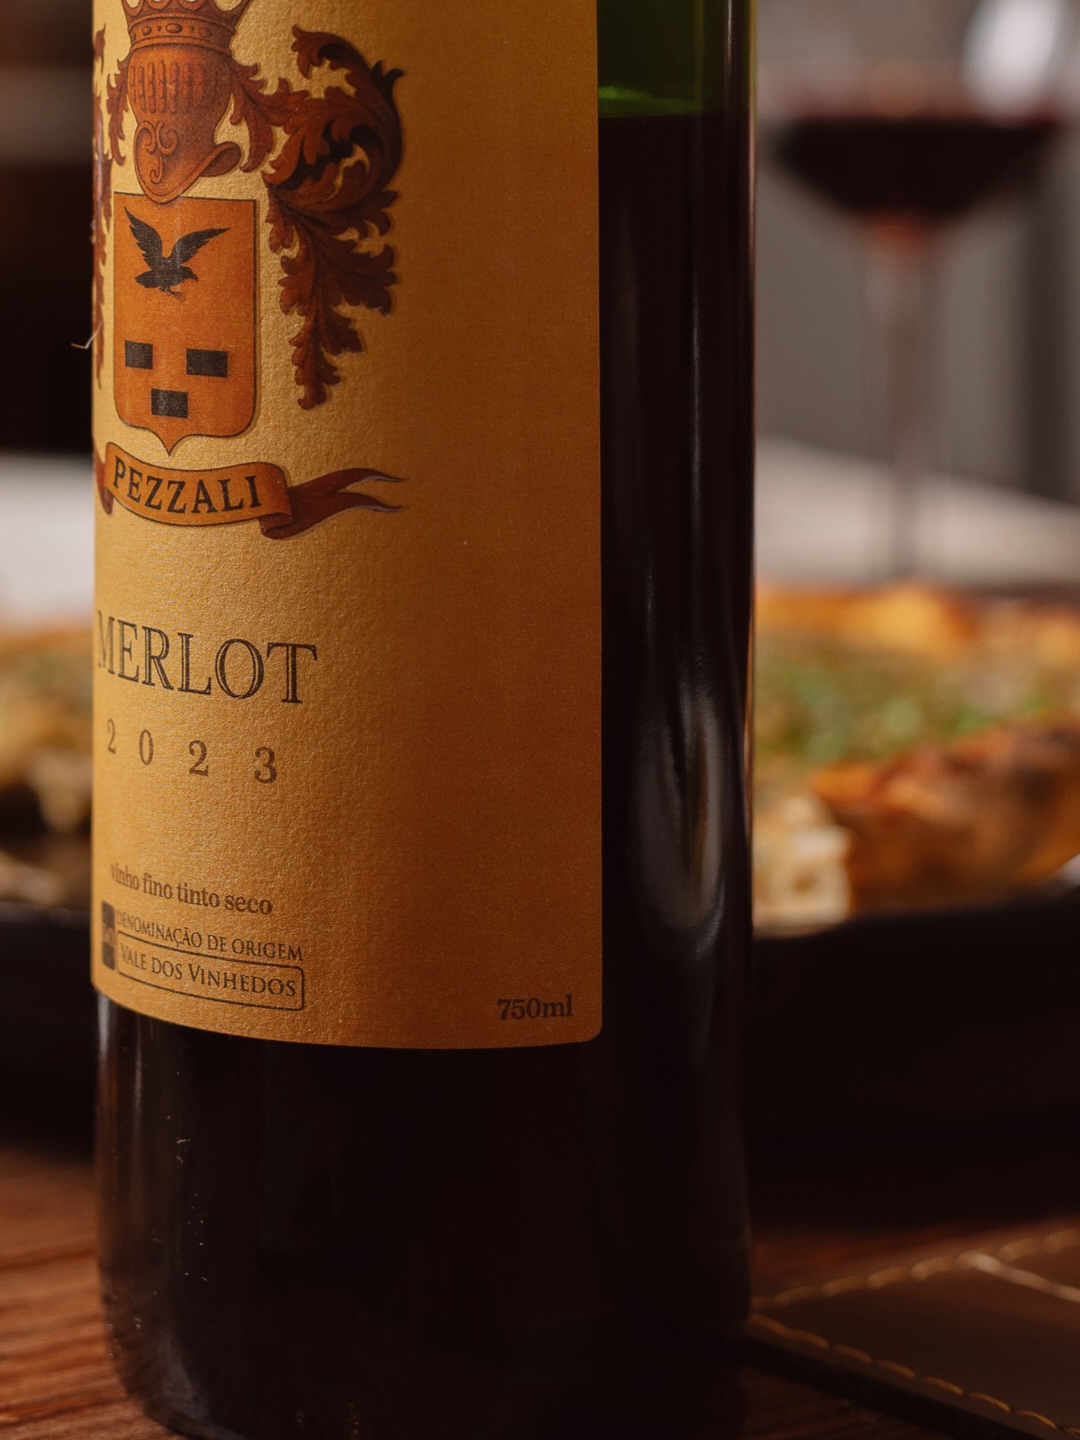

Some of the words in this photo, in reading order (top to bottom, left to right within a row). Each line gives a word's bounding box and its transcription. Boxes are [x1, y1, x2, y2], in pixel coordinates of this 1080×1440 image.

[113, 455, 263, 514] PEZZALI
[98, 610, 318, 704] MERLOT
[110, 863, 140, 891] vinho
[142, 872, 174, 900] fino
[176, 882, 221, 909] tinto
[224, 894, 274, 916] seco
[117, 909, 203, 948] DENOMINAÇÃO
[207, 934, 227, 953] DE
[231, 938, 304, 961] ORIGEM
[120, 943, 147, 971] VALE
[151, 956, 184, 981] DOS
[187, 962, 297, 997] VINHEDOS
[497, 993, 574, 1021] 750ml
